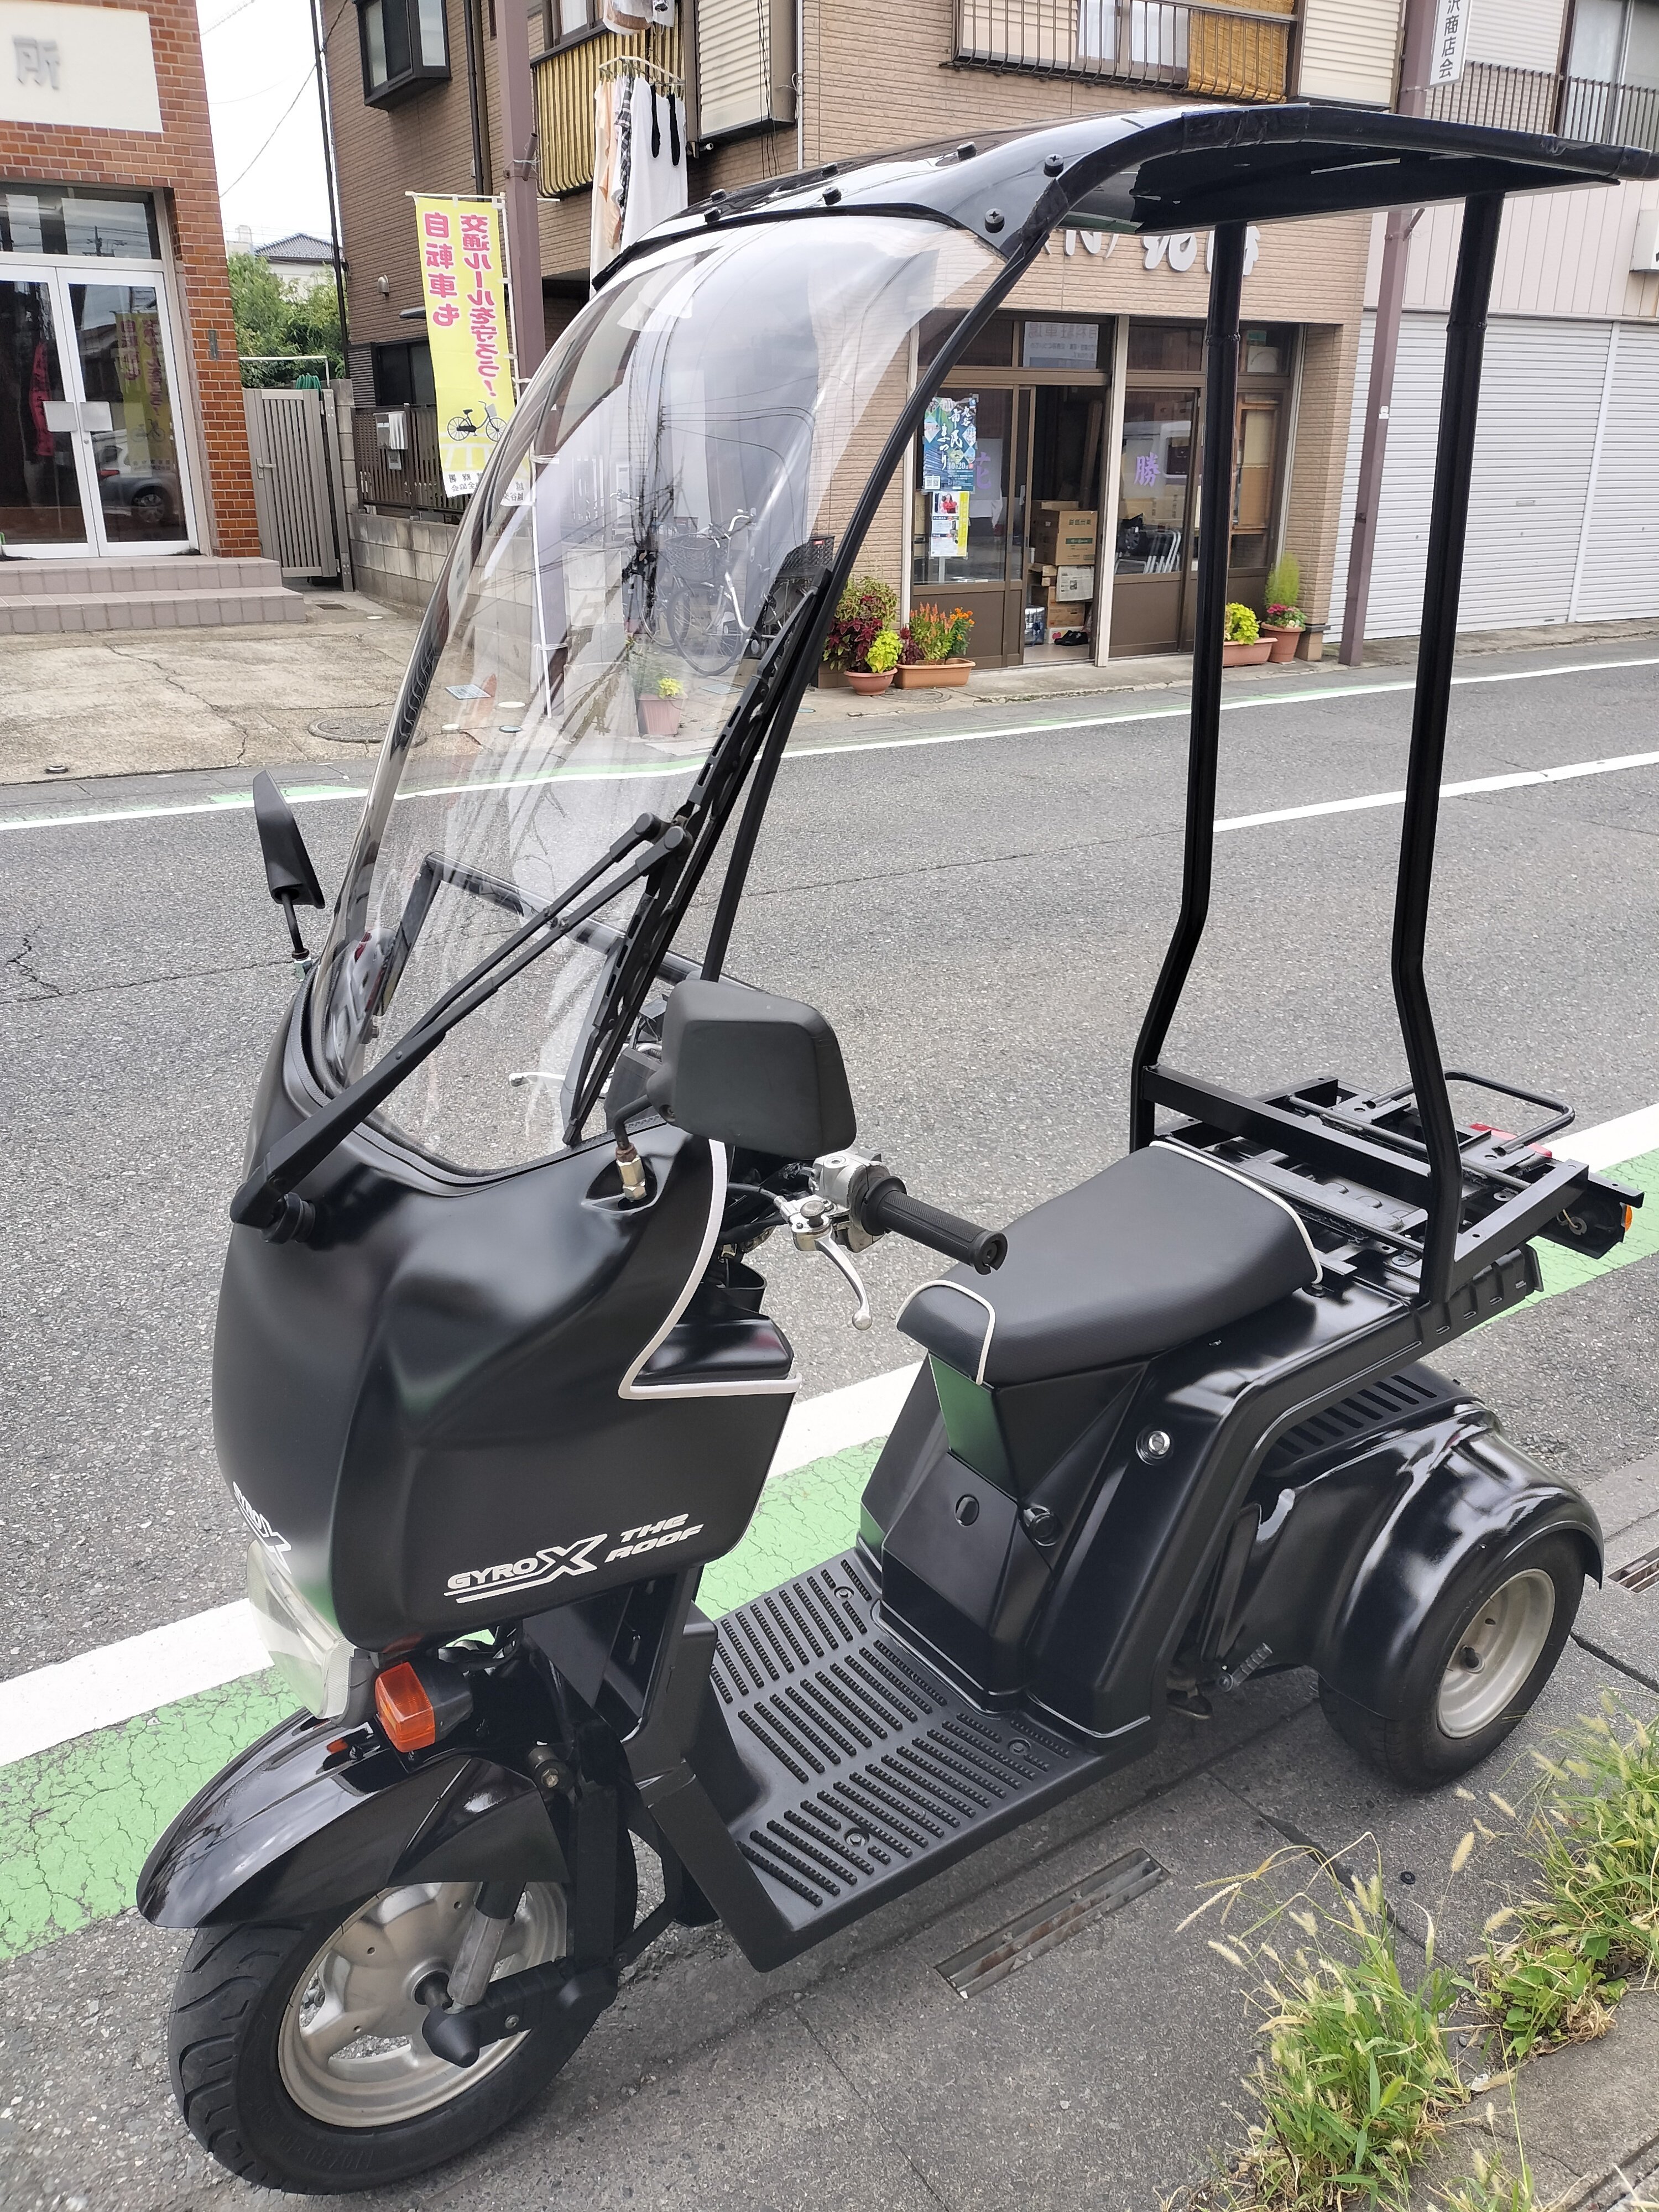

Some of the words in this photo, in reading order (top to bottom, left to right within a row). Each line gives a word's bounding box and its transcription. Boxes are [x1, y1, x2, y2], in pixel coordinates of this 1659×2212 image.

[13, 36, 61, 91] 所
[937, 422, 951, 471] まつり
[1134, 452, 1161, 487] 勝
[604, 1524, 704, 1563] ROOF
